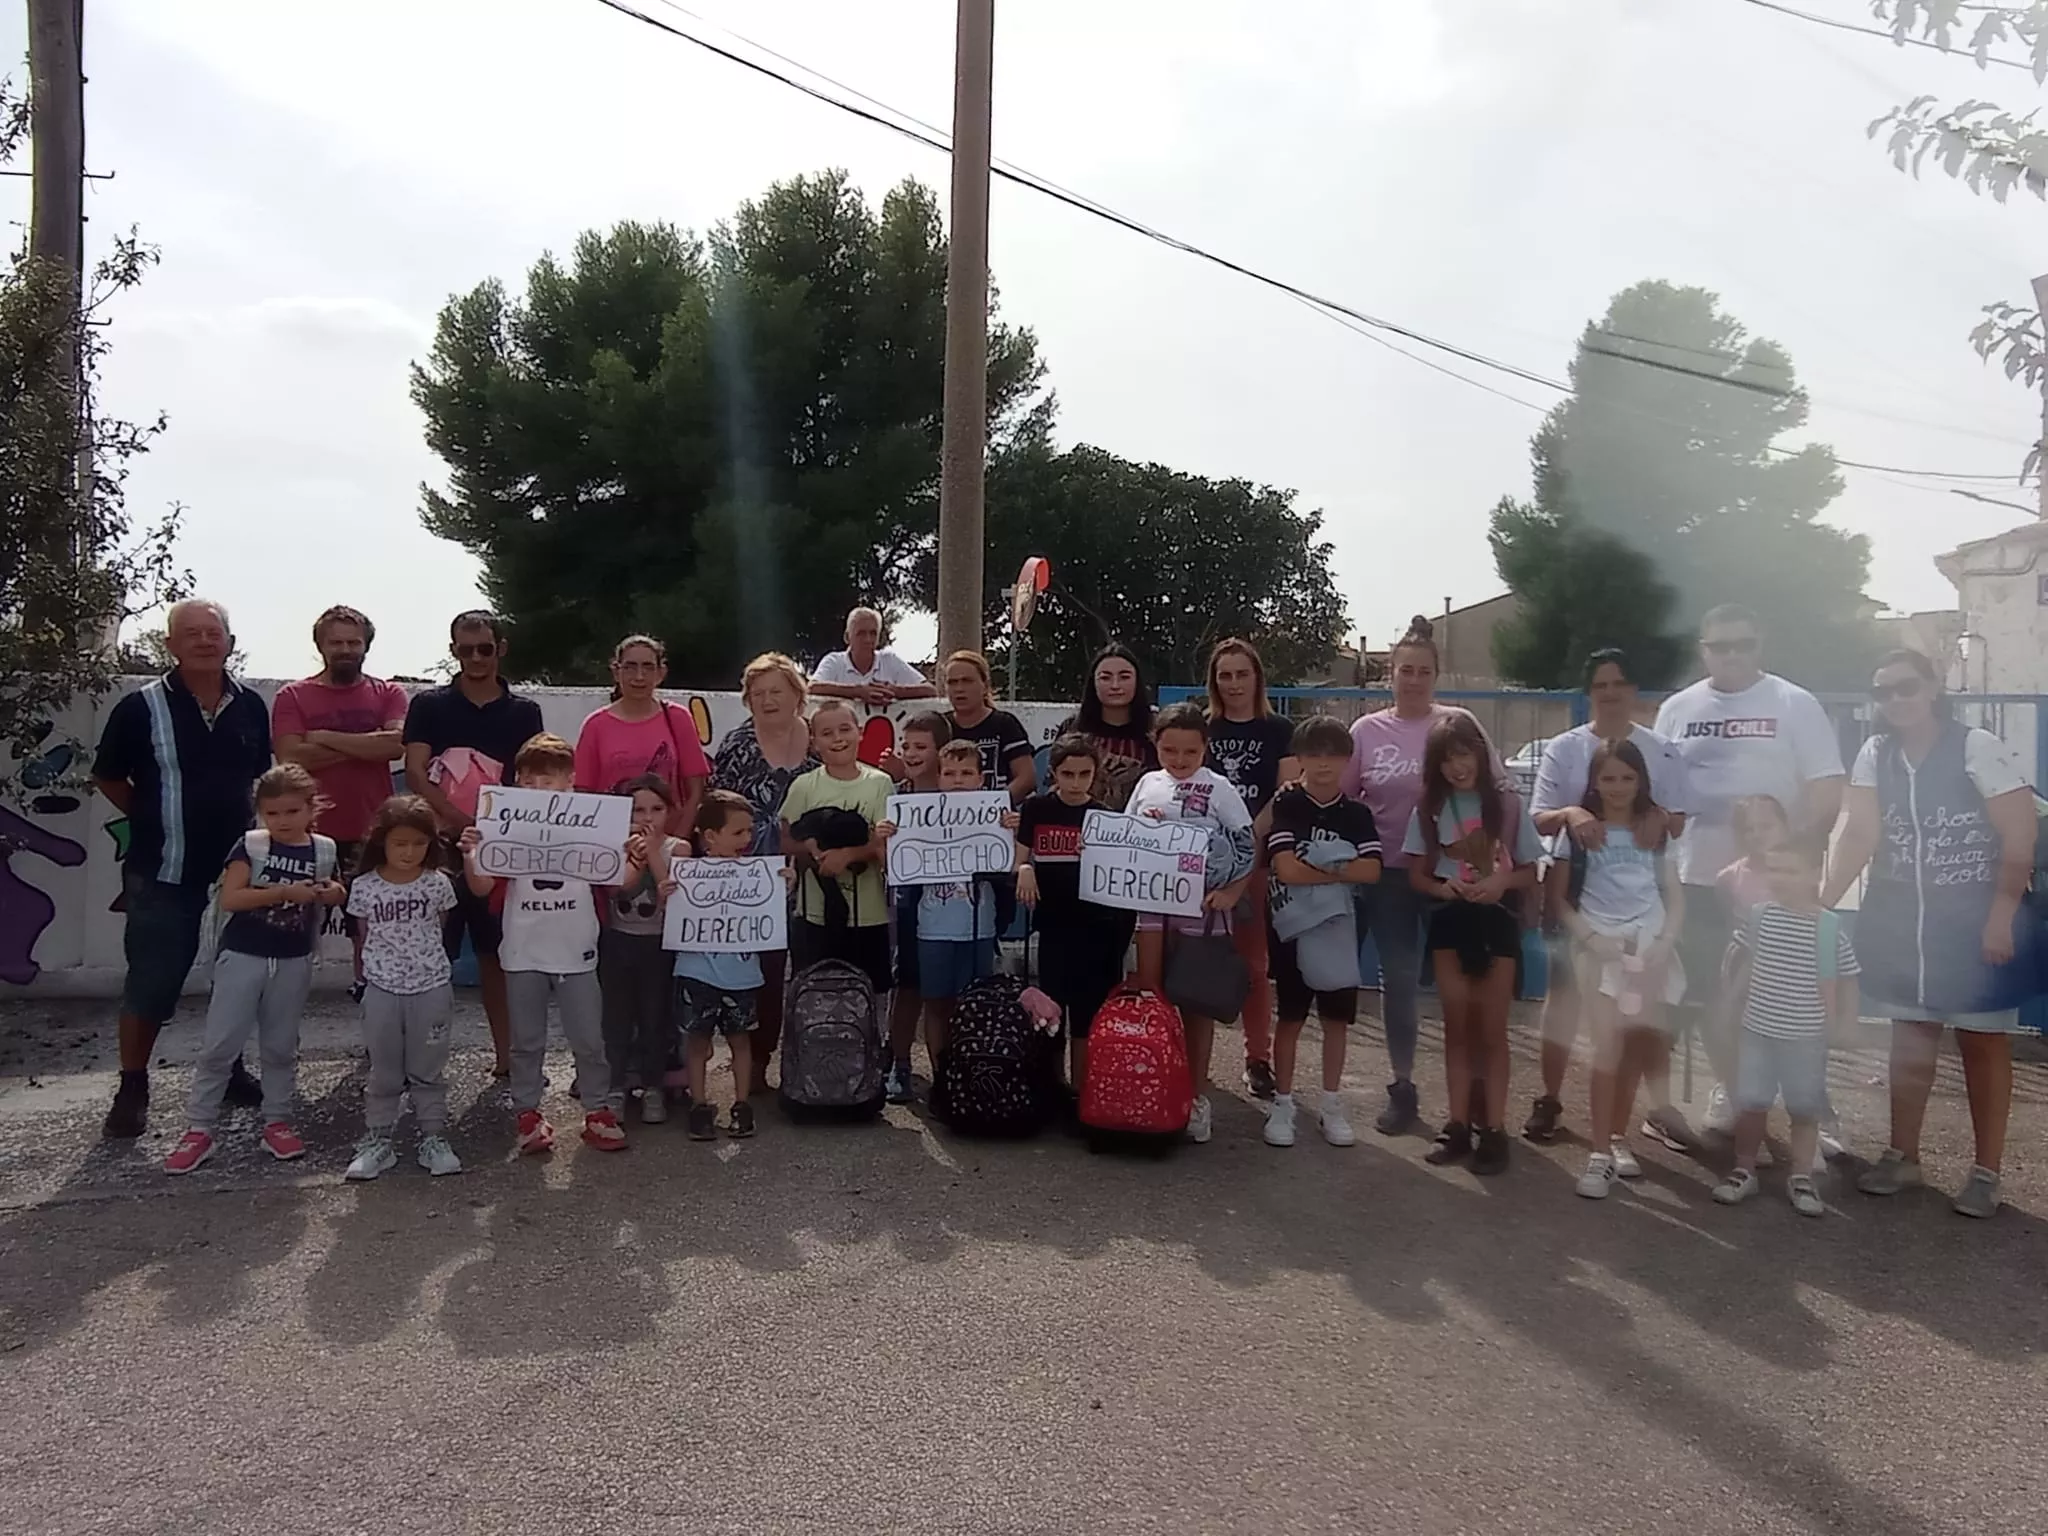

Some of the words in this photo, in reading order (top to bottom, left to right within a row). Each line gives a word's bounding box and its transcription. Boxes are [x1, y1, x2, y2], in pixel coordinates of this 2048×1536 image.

[1684, 721, 1723, 738] JUST
[1208, 738, 1245, 754] ESTOY
[1247, 739, 1264, 754] DE
[1360, 744, 1419, 785] Bar
[479, 790, 603, 836] Igualdad
[490, 846, 617, 875] DERECHO
[747, 863, 762, 879] de
[899, 842, 1006, 878] DERECHO
[691, 880, 762, 902] Calidad
[1092, 863, 1191, 904] DERECHO
[520, 899, 577, 912] KELME
[680, 914, 774, 944] DERECHO
